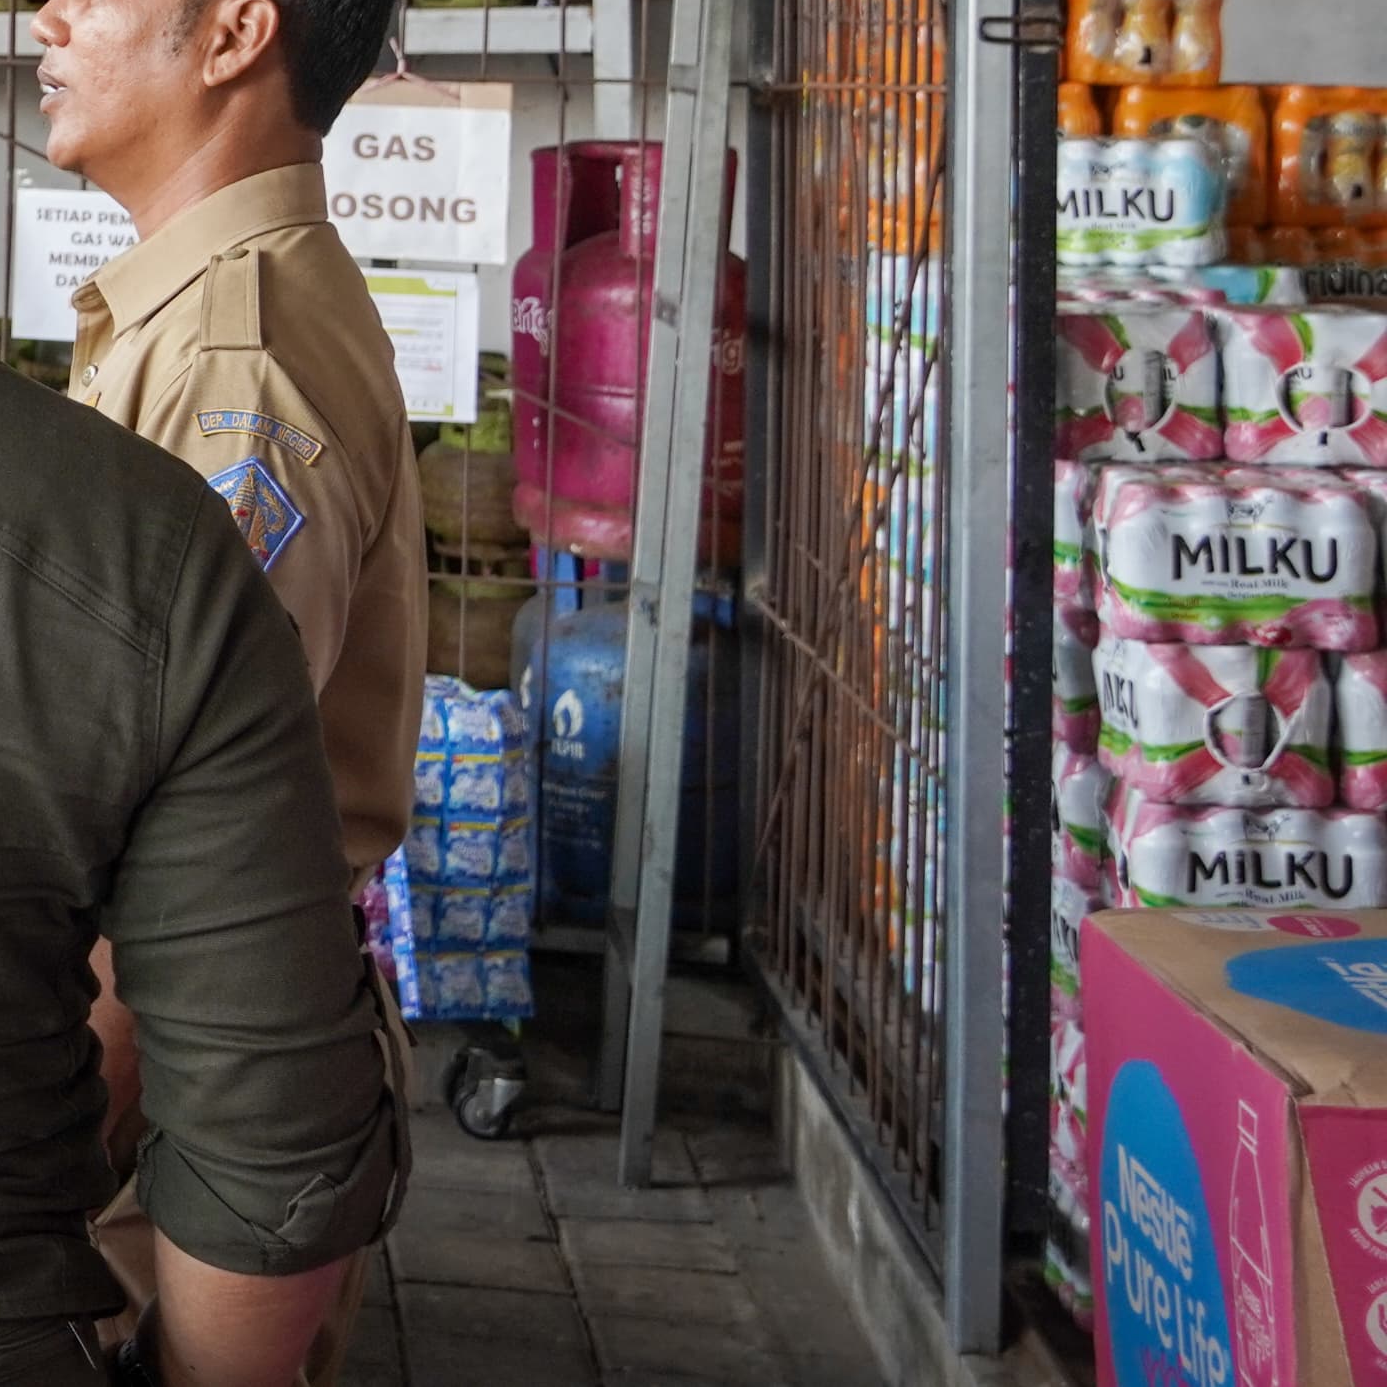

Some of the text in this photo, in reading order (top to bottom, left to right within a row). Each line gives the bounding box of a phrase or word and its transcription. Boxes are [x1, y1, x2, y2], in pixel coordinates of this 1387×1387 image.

[352, 133, 436, 162] GAS
[36, 207, 133, 226] SETIAP PEM
[330, 191, 477, 224] OSONG
[1055, 187, 1175, 223] MILKU
[71, 231, 136, 247] GAS WA
[48, 251, 110, 267] MEMBA
[231, 413, 273, 433] DALAM
[1169, 532, 1339, 585] MILKU
[1186, 849, 1354, 900] MILKU
[1103, 1199, 1173, 1350] Pure
[1174, 1283, 1226, 1387] Life
